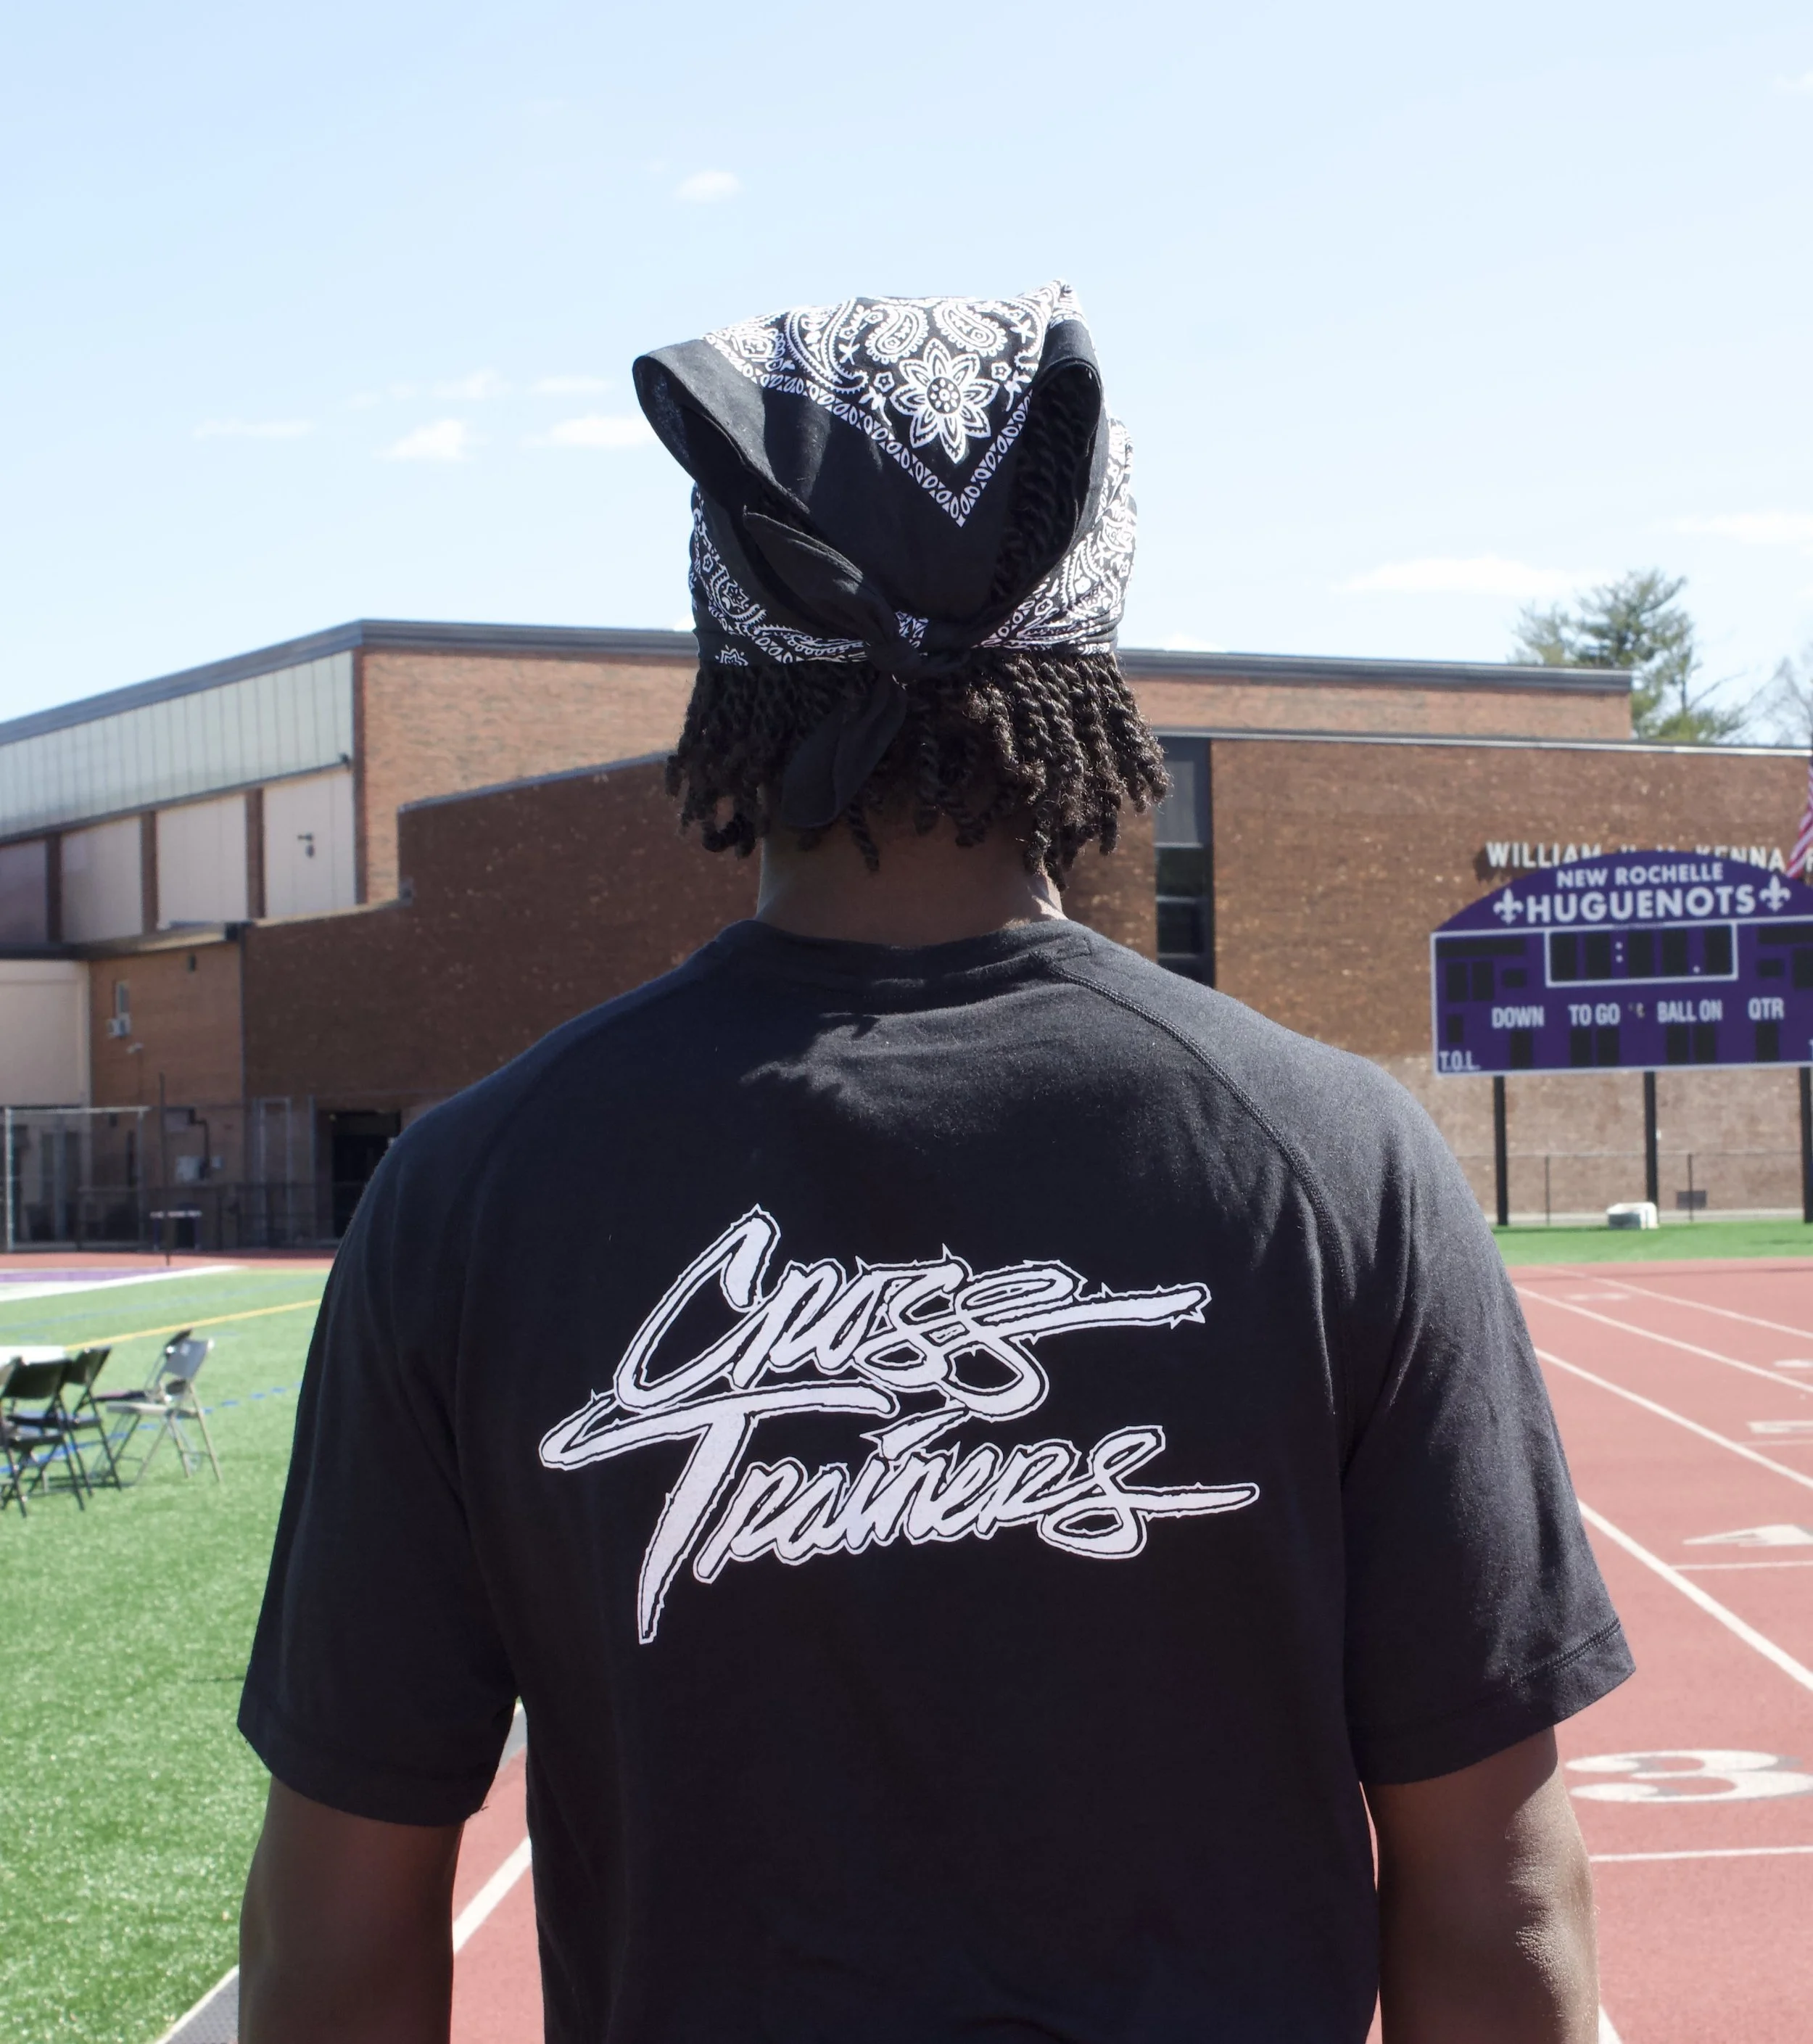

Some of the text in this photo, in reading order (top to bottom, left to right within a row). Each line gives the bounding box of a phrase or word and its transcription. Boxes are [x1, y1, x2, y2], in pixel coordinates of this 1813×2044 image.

[1487, 841, 1601, 868] WILLIAM
[1556, 862, 1723, 888] NEW ROCHELLE
[1527, 884, 1756, 924] HUGUENOTS
[1492, 1006, 1544, 1029] DOWN
[1569, 1002, 1620, 1026] TO GO
[1657, 999, 1723, 1023] BALL ON
